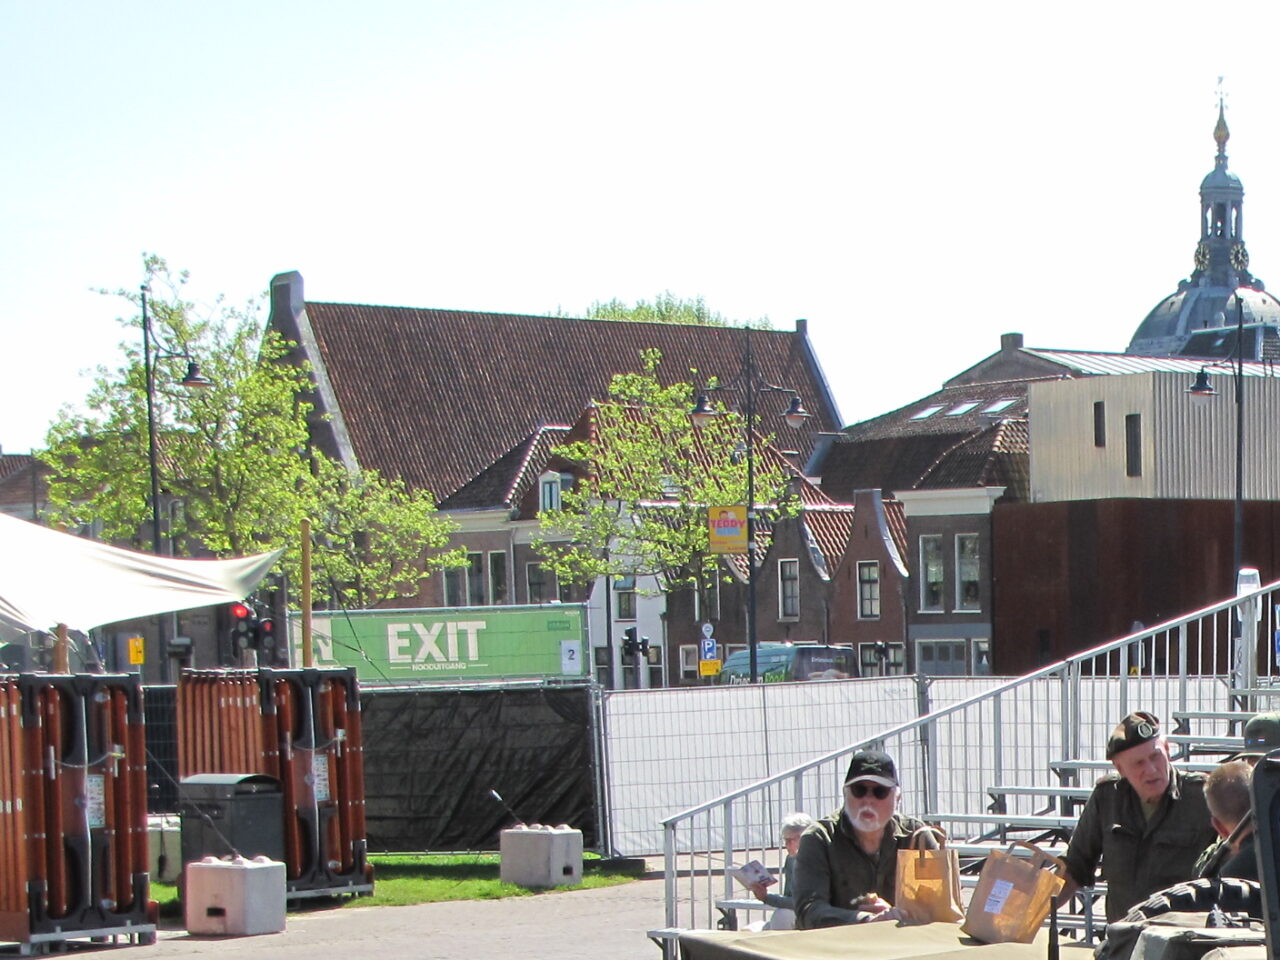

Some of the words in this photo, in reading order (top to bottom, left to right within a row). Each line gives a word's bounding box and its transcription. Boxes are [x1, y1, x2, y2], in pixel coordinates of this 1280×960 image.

[387, 620, 487, 663] EXIT
[704, 641, 712, 651] P
[567, 649, 575, 661] 2
[411, 662, 467, 671] NOODUITGANG
